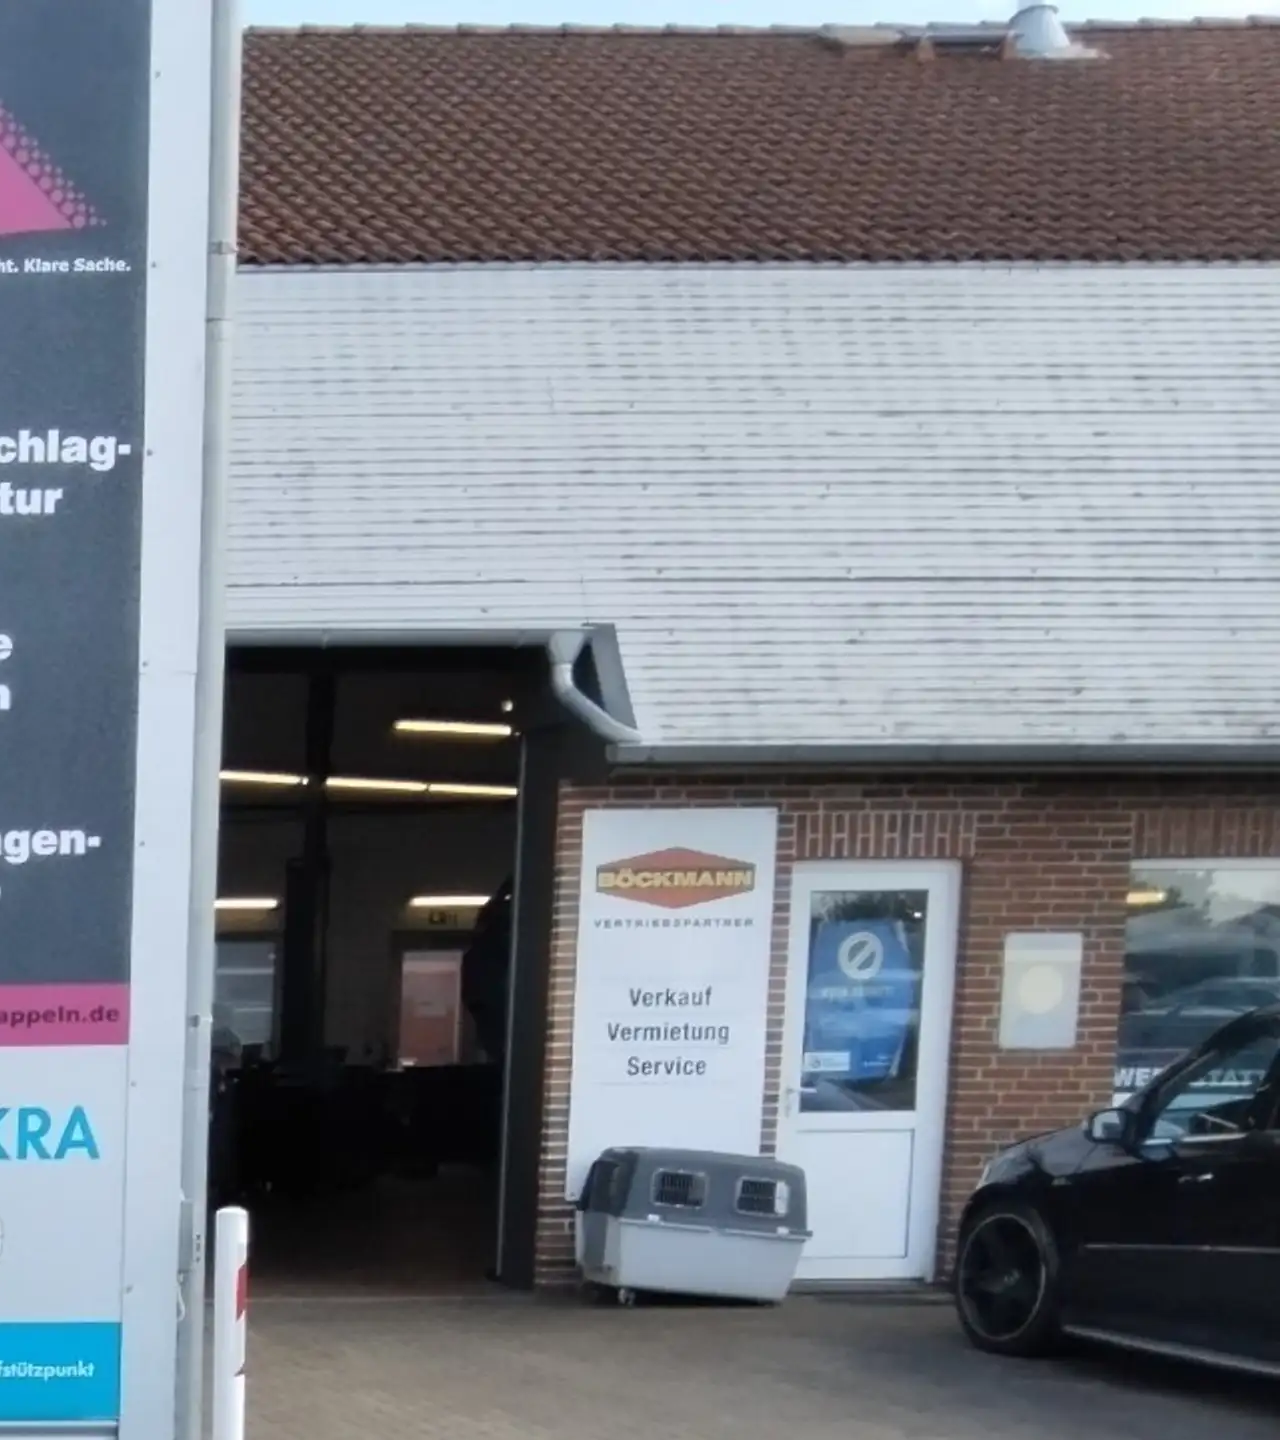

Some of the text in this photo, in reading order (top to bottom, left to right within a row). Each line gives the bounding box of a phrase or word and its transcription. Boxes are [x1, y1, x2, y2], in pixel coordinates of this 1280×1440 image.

[23, 257, 70, 273] Klare
[73, 256, 132, 273] Sache.
[598, 868, 754, 888] BÖCKMANN
[629, 985, 713, 1007] Verkauf
[607, 1021, 730, 1046] Vermietung
[626, 1055, 707, 1076] Service
